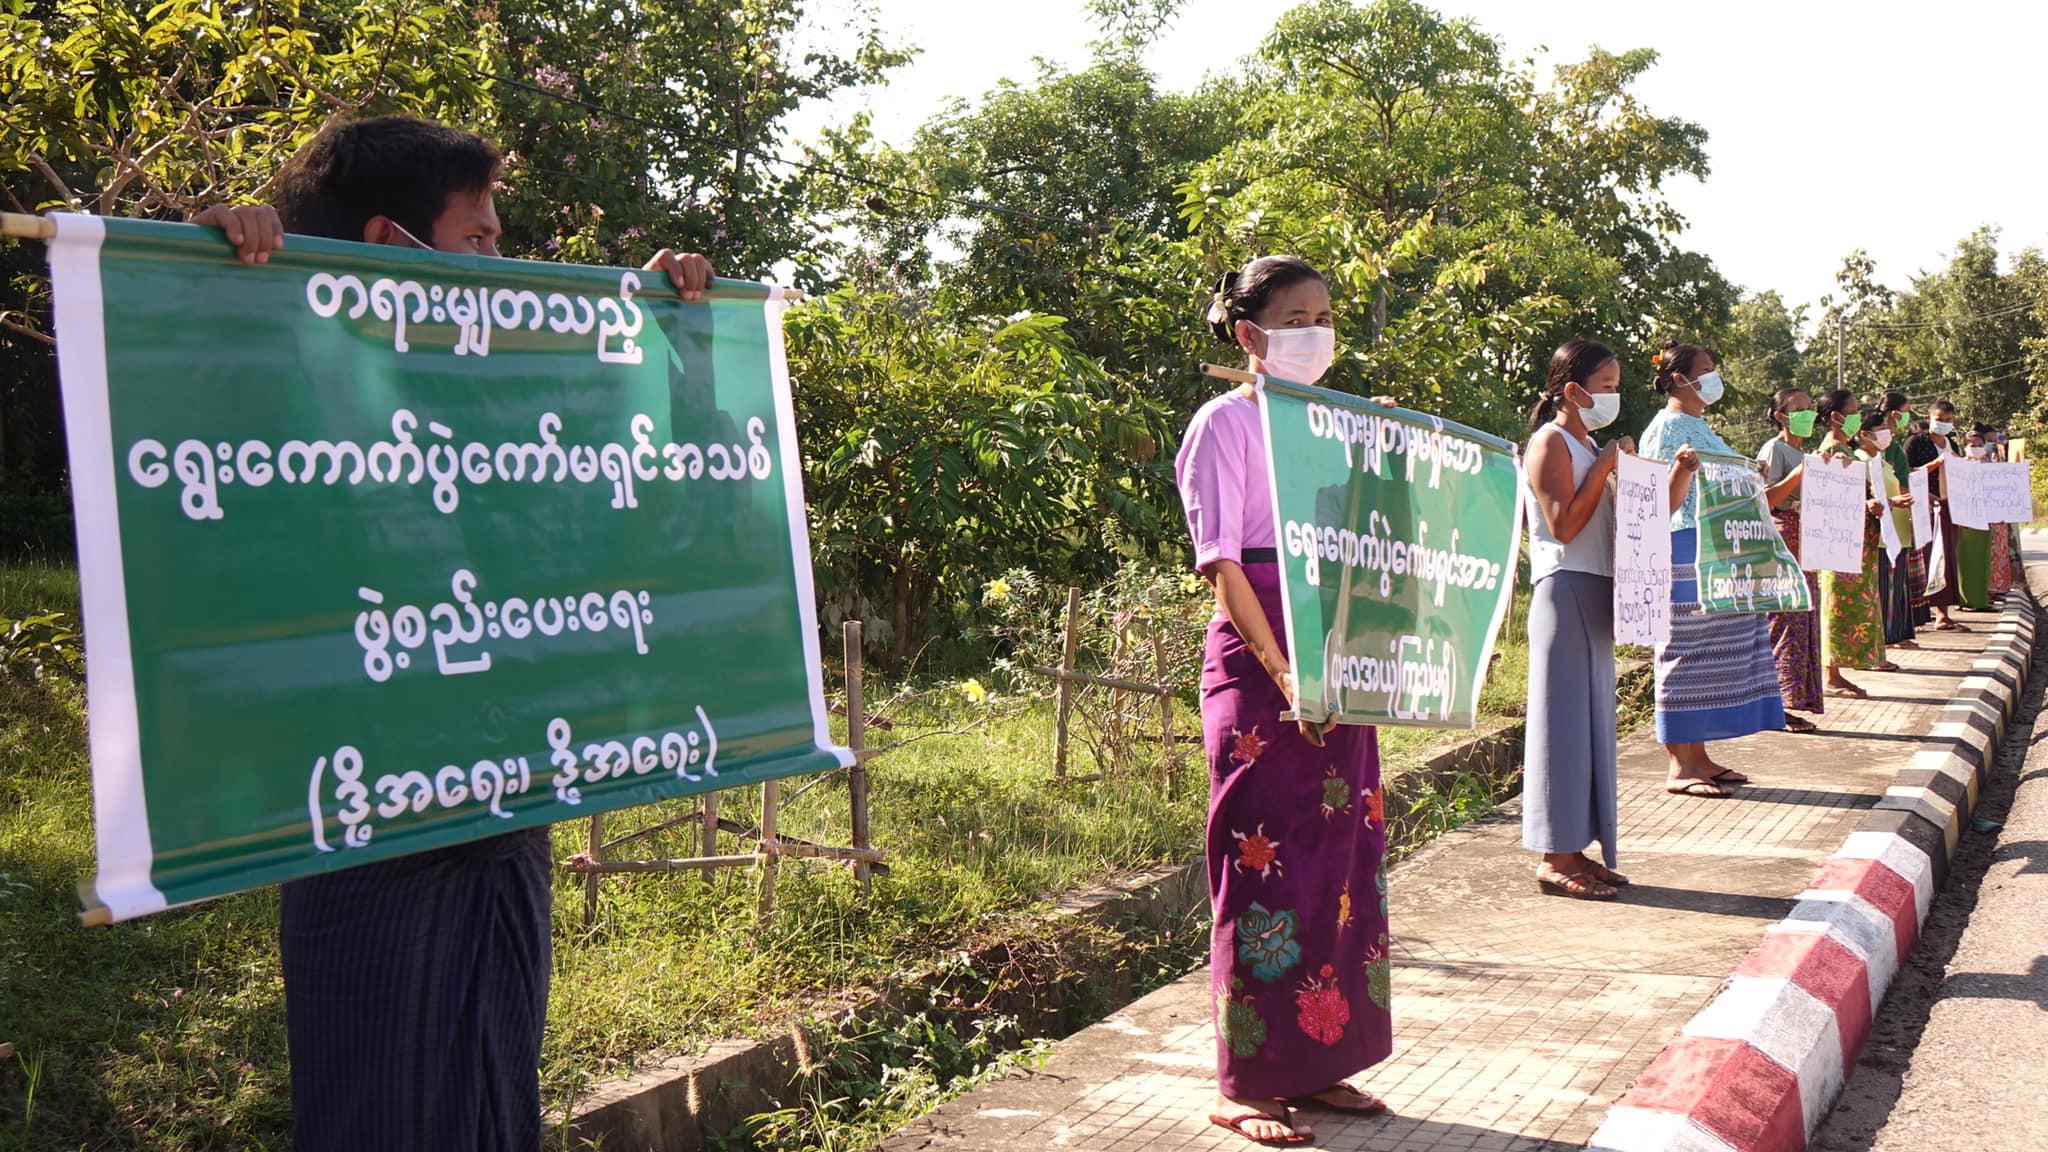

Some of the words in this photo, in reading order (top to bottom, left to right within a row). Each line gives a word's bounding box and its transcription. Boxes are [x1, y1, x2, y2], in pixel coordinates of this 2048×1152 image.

[306, 271, 644, 366] တရားမျှတသည့်
[127, 408, 772, 521] ရွေးကောက်ပွဲကော်မရှင်အသစ်
[354, 569, 654, 682] ဖွဲ့စည်းပေးရေး
